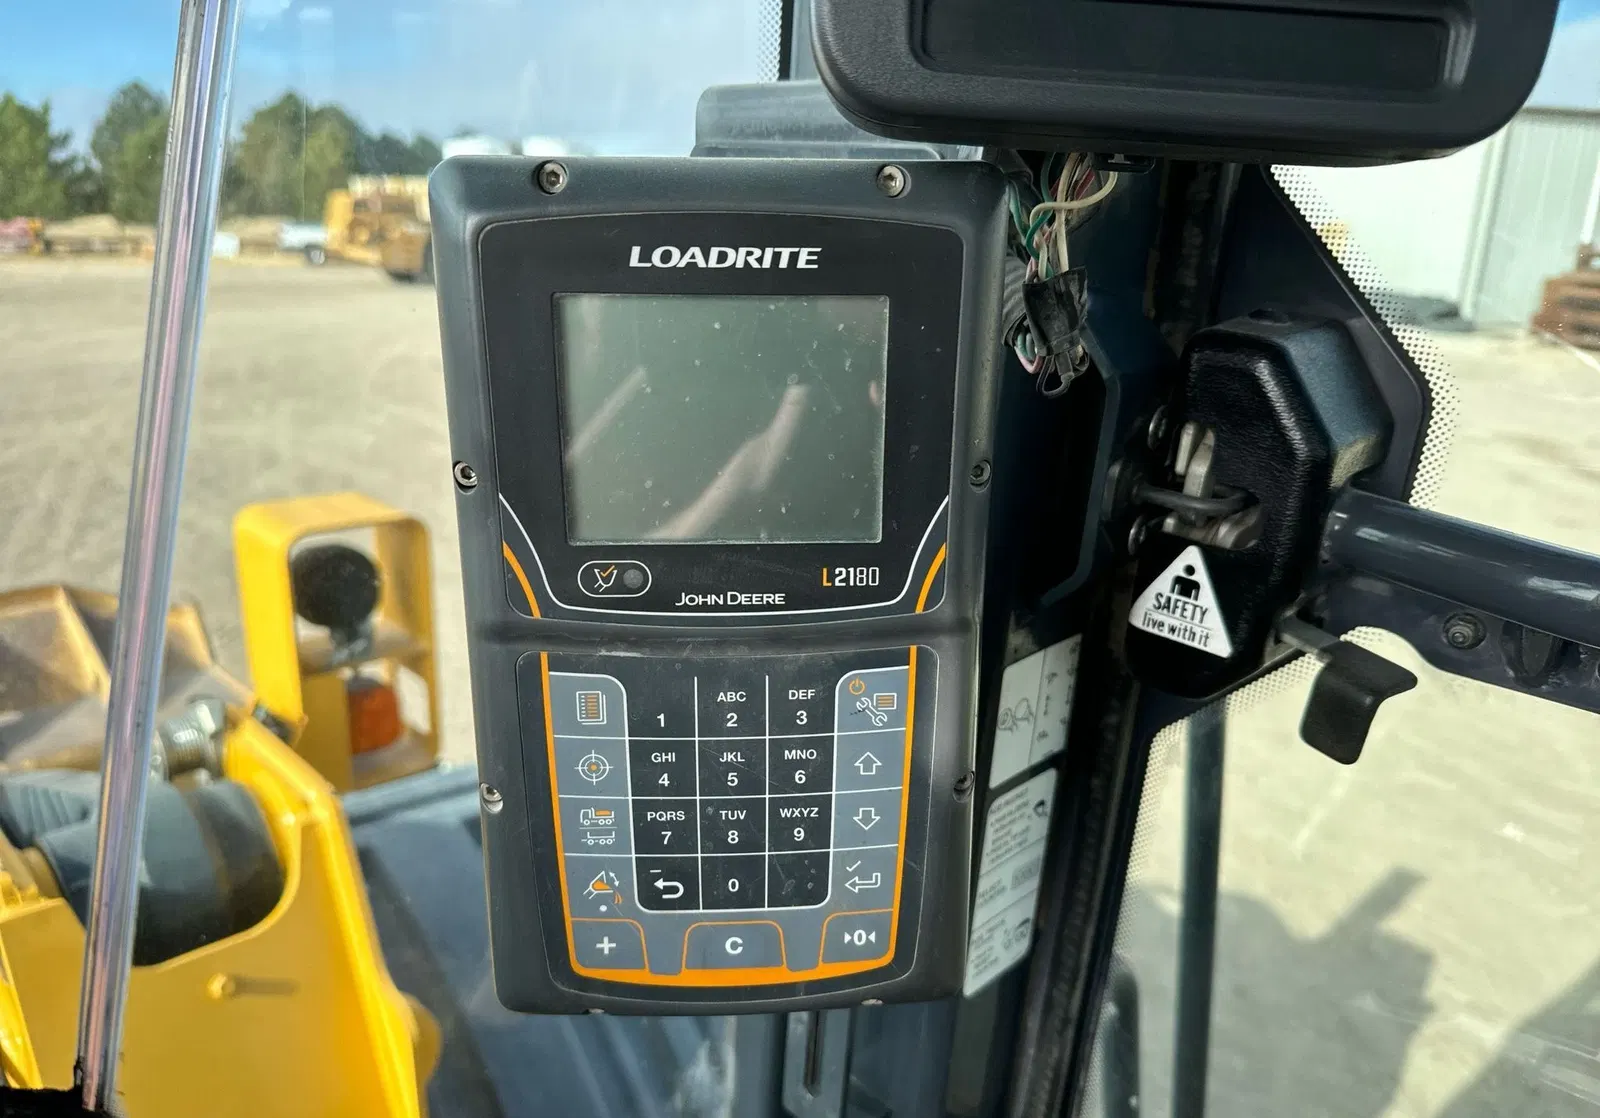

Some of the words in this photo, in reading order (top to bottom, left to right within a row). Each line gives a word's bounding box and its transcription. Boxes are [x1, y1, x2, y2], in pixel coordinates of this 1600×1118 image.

[628, 245, 822, 269] LOADRITE
[821, 566, 880, 587] L2180
[674, 592, 724, 606] JOHN
[726, 592, 786, 606] DEERE
[1152, 592, 1208, 625] SAFETY
[1141, 611, 1165, 632] live
[1167, 621, 1196, 643] with
[1198, 630, 1210, 647] it
[716, 691, 747, 703] ABC
[788, 689, 816, 700] DEF
[655, 713, 666, 728] 1
[726, 712, 738, 727] 2
[795, 710, 808, 725] 3
[651, 751, 676, 763] GHI
[719, 751, 746, 763] JKL
[784, 748, 817, 760] MNO
[658, 772, 670, 787] 4
[727, 772, 739, 787] 5
[794, 769, 806, 784] 6
[647, 810, 686, 822] PQRS
[719, 809, 747, 821] TUV
[779, 807, 819, 818] WXYZ
[661, 831, 672, 845] 7
[727, 829, 739, 844] 8
[793, 827, 805, 842] 9
[727, 878, 740, 893] 0
[724, 936, 744, 955] C
